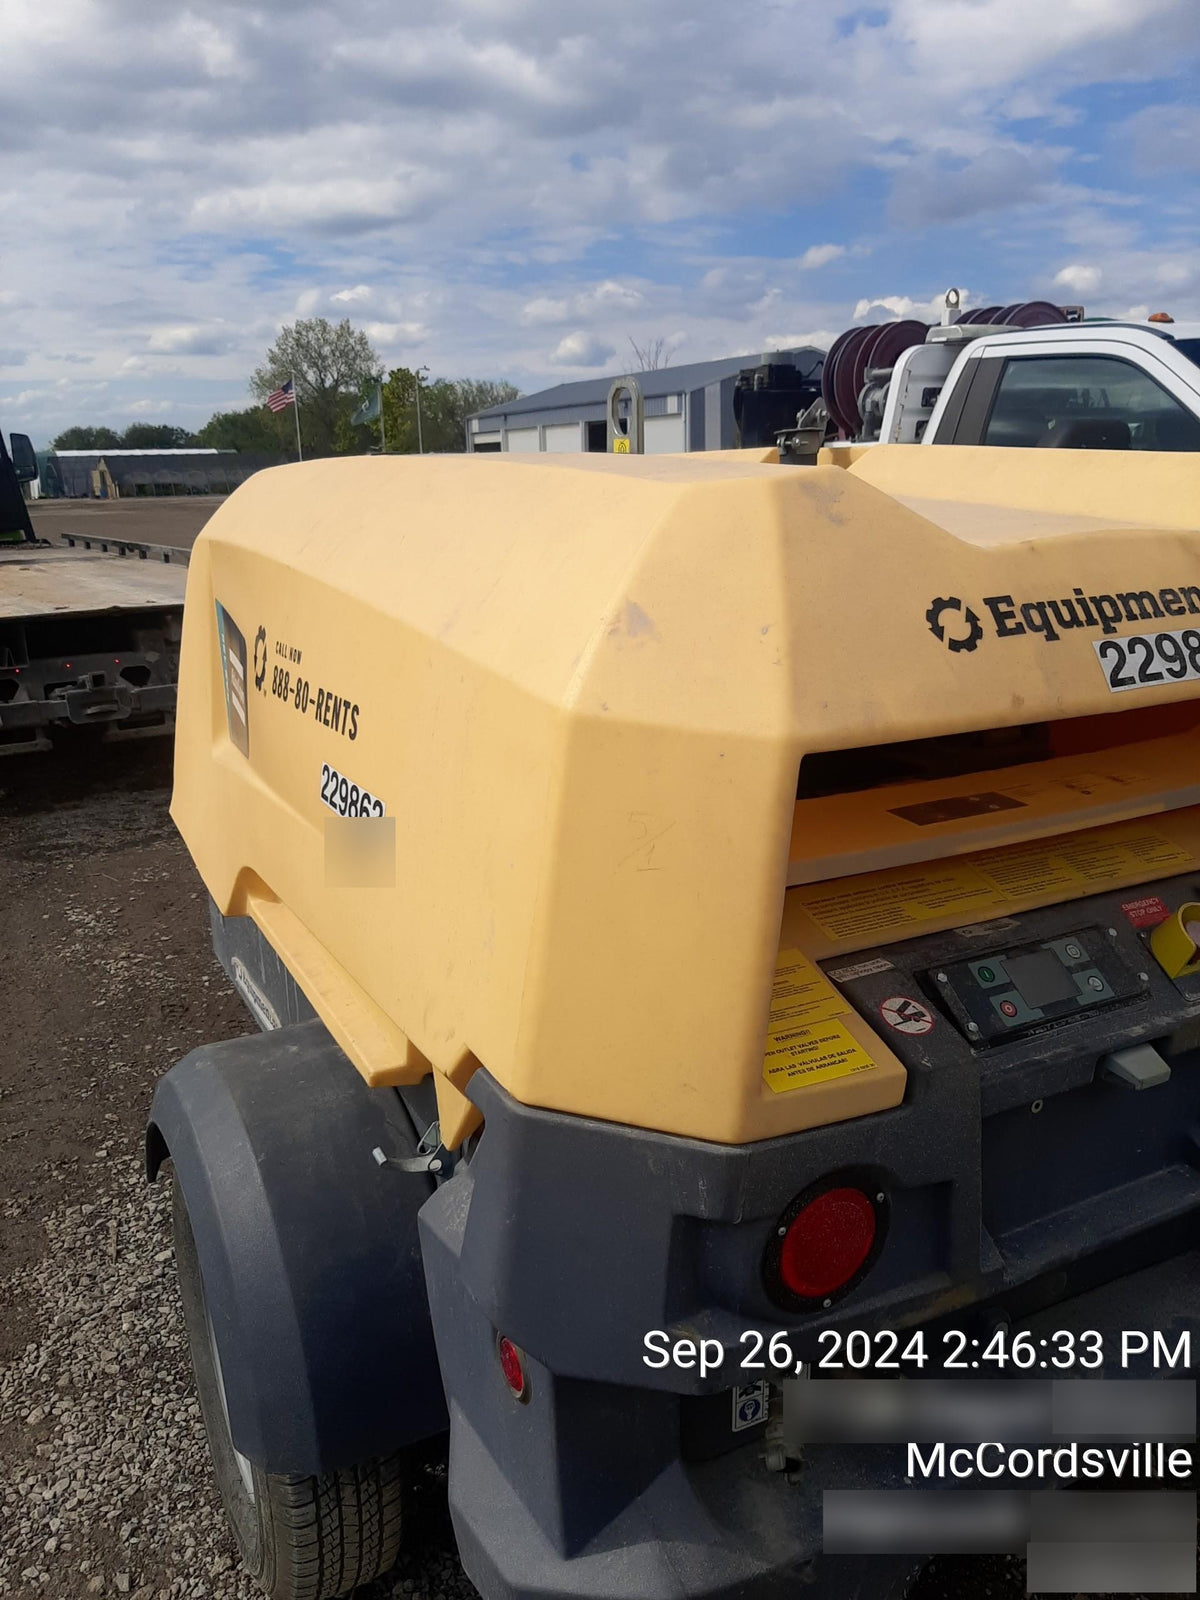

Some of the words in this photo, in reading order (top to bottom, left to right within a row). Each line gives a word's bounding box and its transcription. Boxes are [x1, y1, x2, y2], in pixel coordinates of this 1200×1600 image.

[275, 640, 287, 659] CALL
[289, 646, 302, 664] NOW
[271, 665, 360, 741] 888-80-RENTS
[1129, 909, 1146, 918] STOP
[1146, 905, 1163, 914] ONLY
